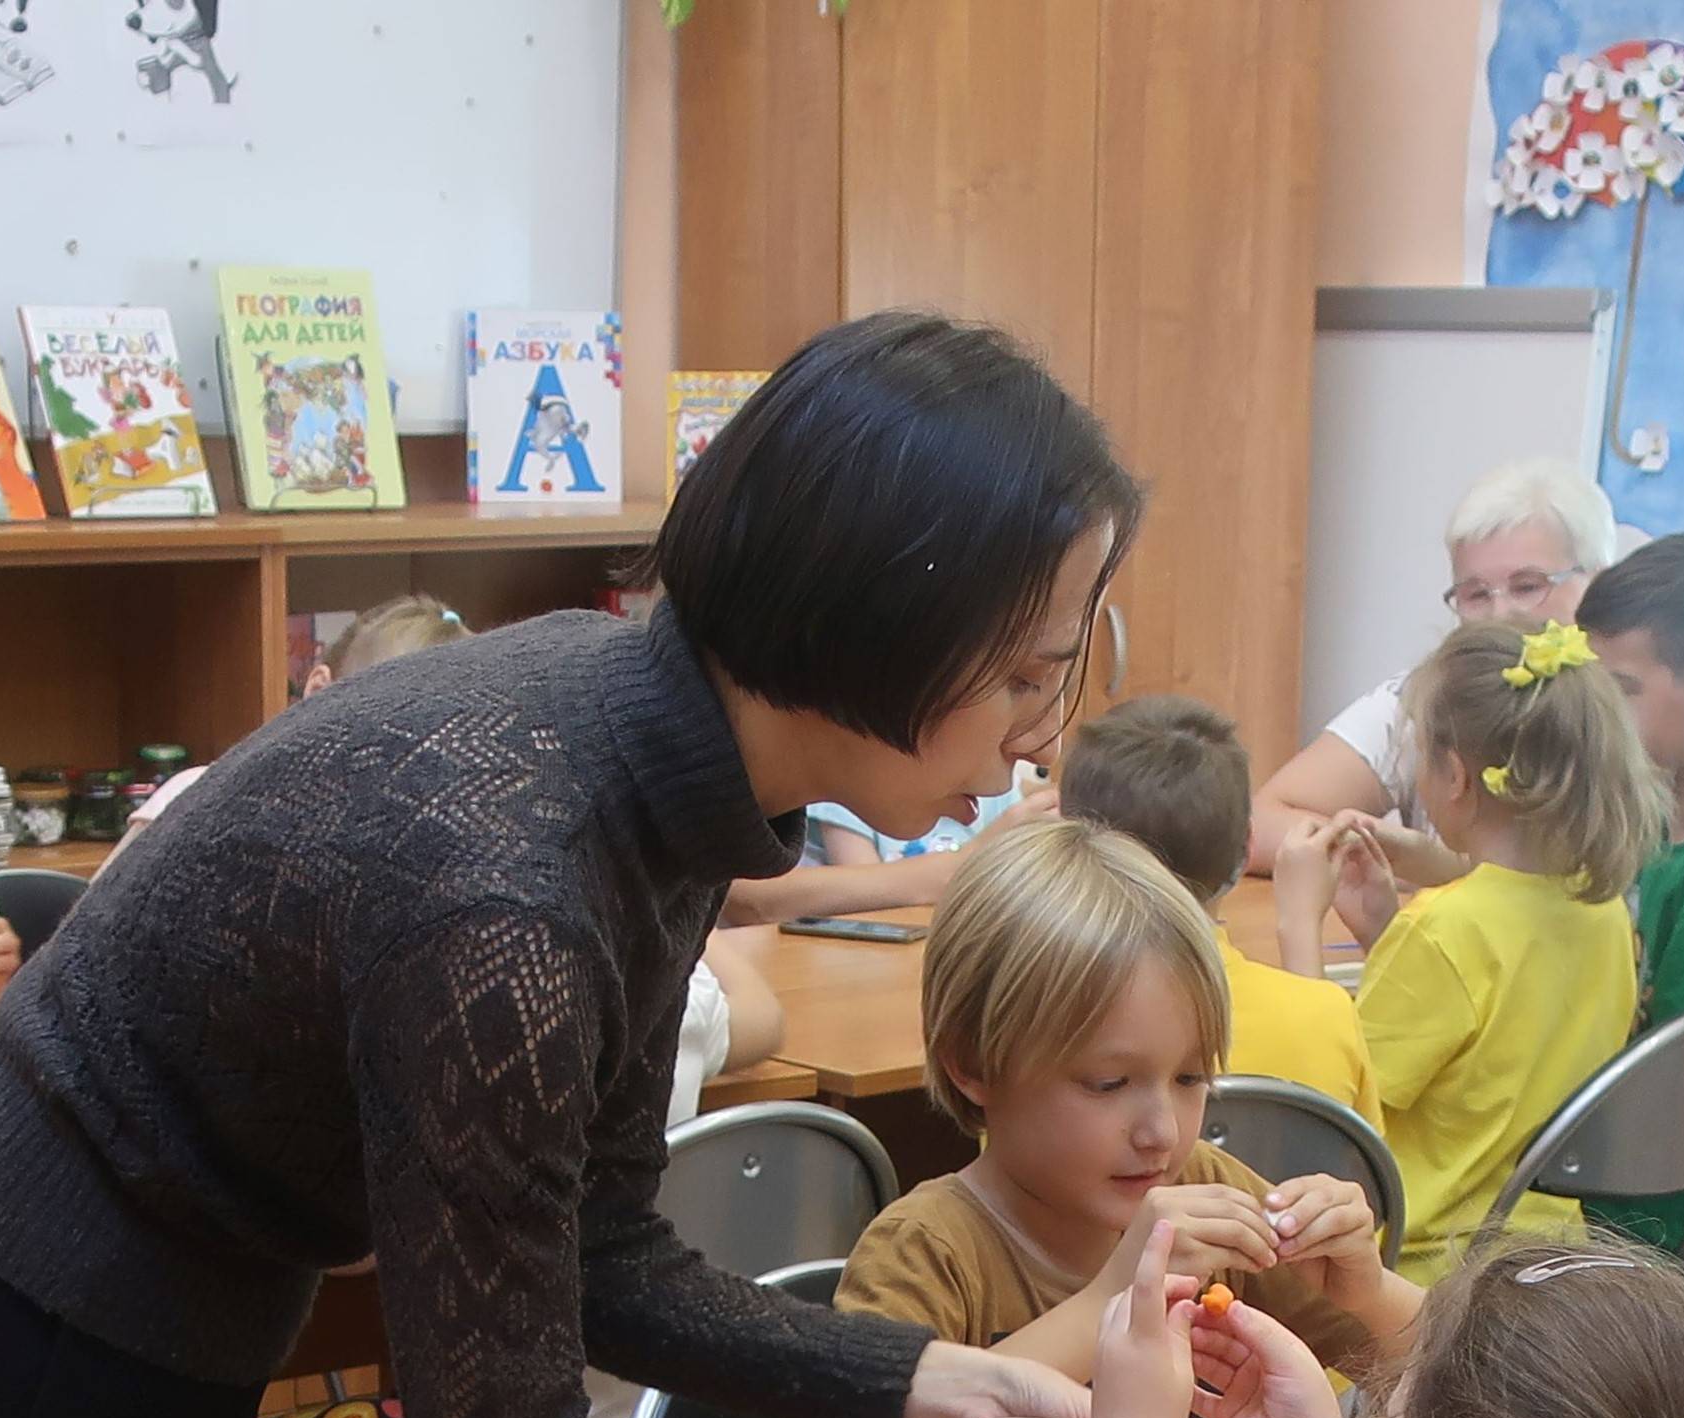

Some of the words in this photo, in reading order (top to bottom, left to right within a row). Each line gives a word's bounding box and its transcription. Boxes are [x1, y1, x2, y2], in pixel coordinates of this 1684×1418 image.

[236, 293, 362, 317] ГЕОГРАФИЯ
[243, 322, 289, 344] ДЛЯ
[297, 317, 366, 345] ДЕТЕЙ
[494, 340, 594, 362] АЗБУКА
